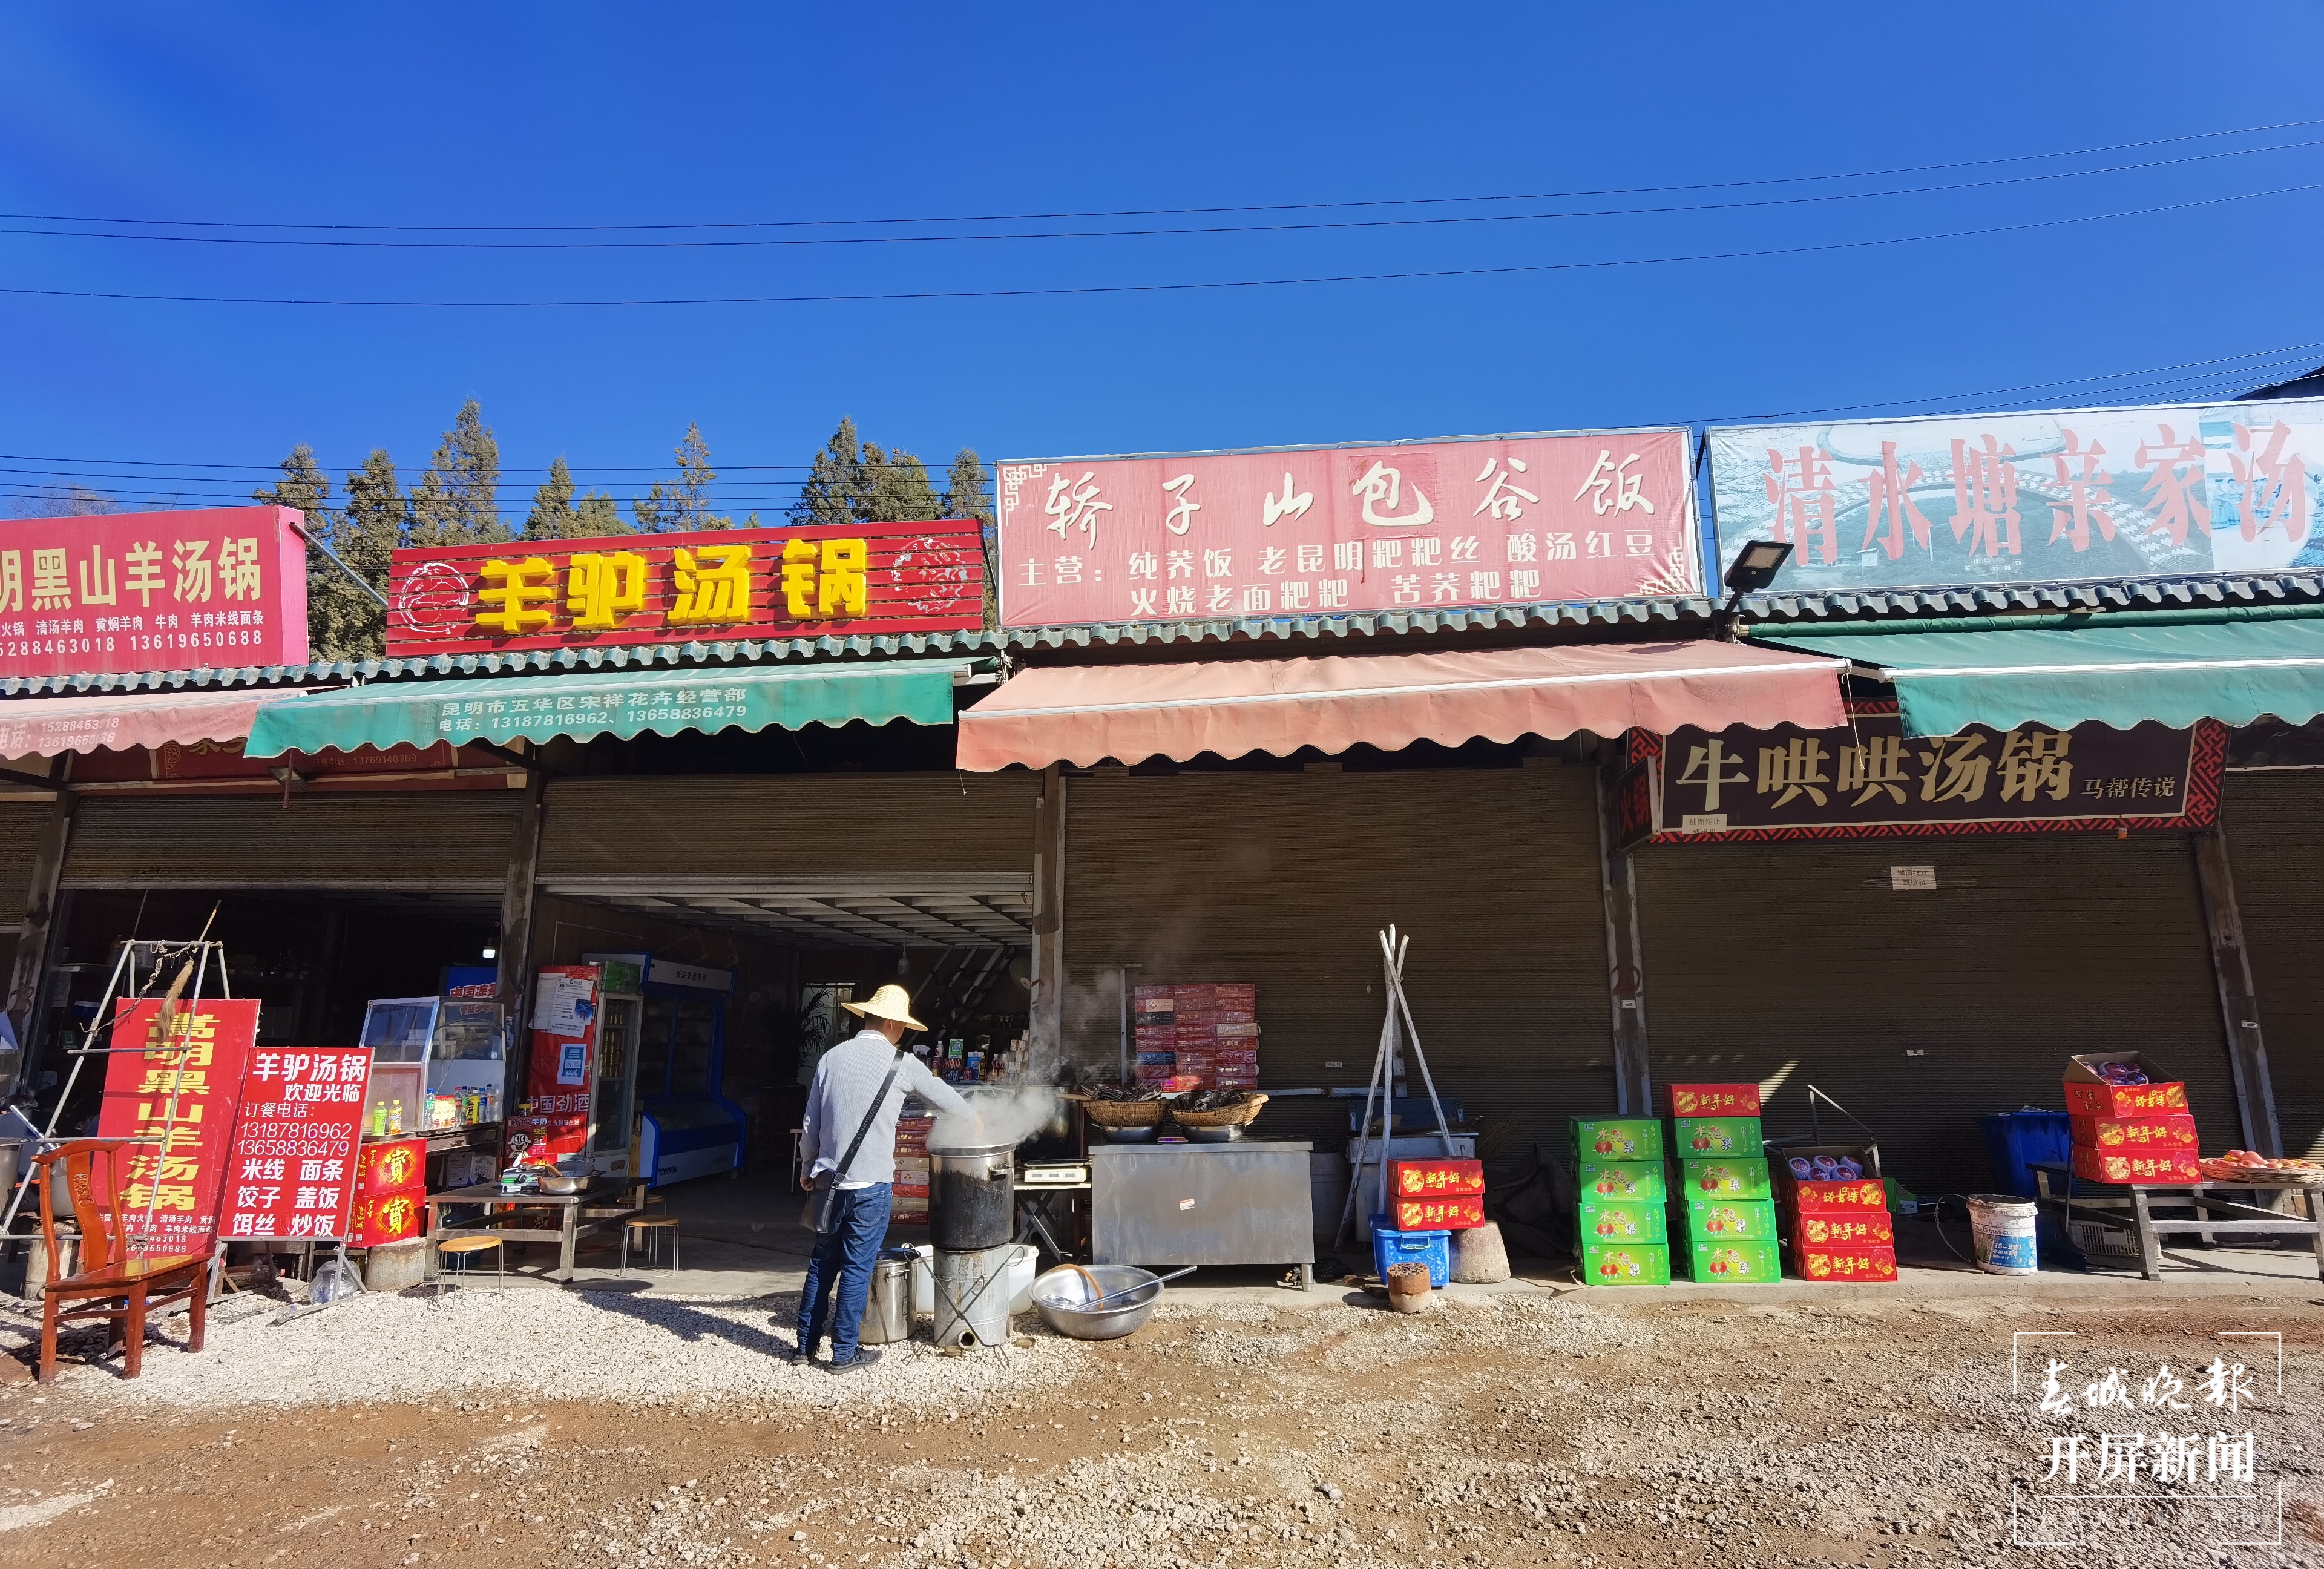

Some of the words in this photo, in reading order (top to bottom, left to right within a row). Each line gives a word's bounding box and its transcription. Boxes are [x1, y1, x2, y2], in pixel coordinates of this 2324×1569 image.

[1045, 450, 1655, 550] 轿子山包谷饭
[1762, 419, 2306, 565] 清水塘亲家汤
[1129, 548, 1232, 580] 纯荞饭
[1258, 535, 1481, 575] 老昆明粑粑丝
[1507, 529, 1656, 562] 酸汤红豆
[475, 538, 867, 631] 羊驴汤锅
[1131, 579, 1349, 616] 火烧老面粑粑
[1391, 570, 1541, 604] 苦荞粑粑
[36, 618, 84, 636] 清汤羊肉
[96, 615, 143, 633] 黄焖羊肉
[155, 613, 178, 629] 牛肉
[191, 610, 264, 628] 羊肉米线面条
[131, 630, 261, 650] 13619650688
[442, 688, 747, 717] 昆明市五华区宋祥花卉经营部
[627, 705, 747, 722] 13658836479
[1675, 731, 2072, 811] 牛哄哄汤锅
[2081, 776, 2175, 800] 马帮传说
[253, 1053, 367, 1082] 羊驴汤锅
[283, 1084, 361, 1102] 欢迎光临
[527, 1094, 589, 1113] 中国劲酒
[241, 1122, 352, 1139] 13187816962
[237, 1139, 349, 1157] 13658836479
[240, 1157, 286, 1181] 米线
[300, 1159, 344, 1182] 面条
[237, 1185, 280, 1208] 饺子
[294, 1186, 341, 1209] 盖饭
[232, 1212, 276, 1236] 饵丝
[289, 1214, 336, 1237] 炒饭
